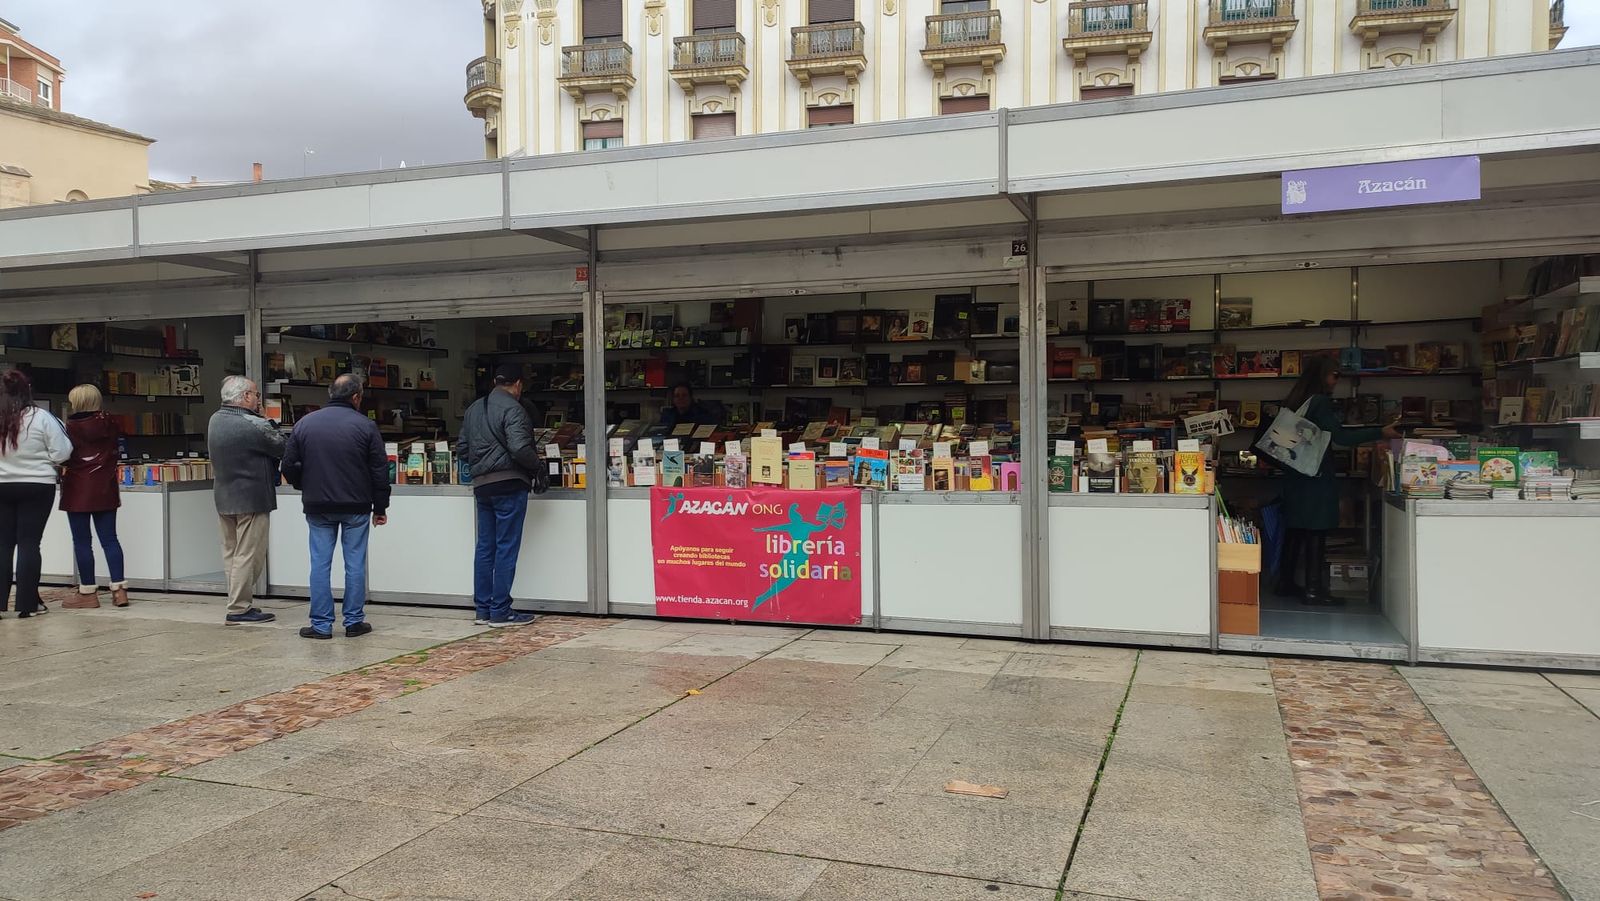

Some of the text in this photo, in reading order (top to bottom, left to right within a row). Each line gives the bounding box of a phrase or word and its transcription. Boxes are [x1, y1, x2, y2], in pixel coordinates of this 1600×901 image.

[1357, 176, 1428, 194] Azacán
[1014, 243, 1026, 252] 26
[679, 498, 783, 516] AZACÁN ONG
[670, 545, 700, 553] Apóyanos
[766, 534, 845, 555] librería
[725, 560, 746, 568] mundo
[759, 559, 852, 580] solidaria
[656, 594, 749, 608] www.tienda.azacan.org
